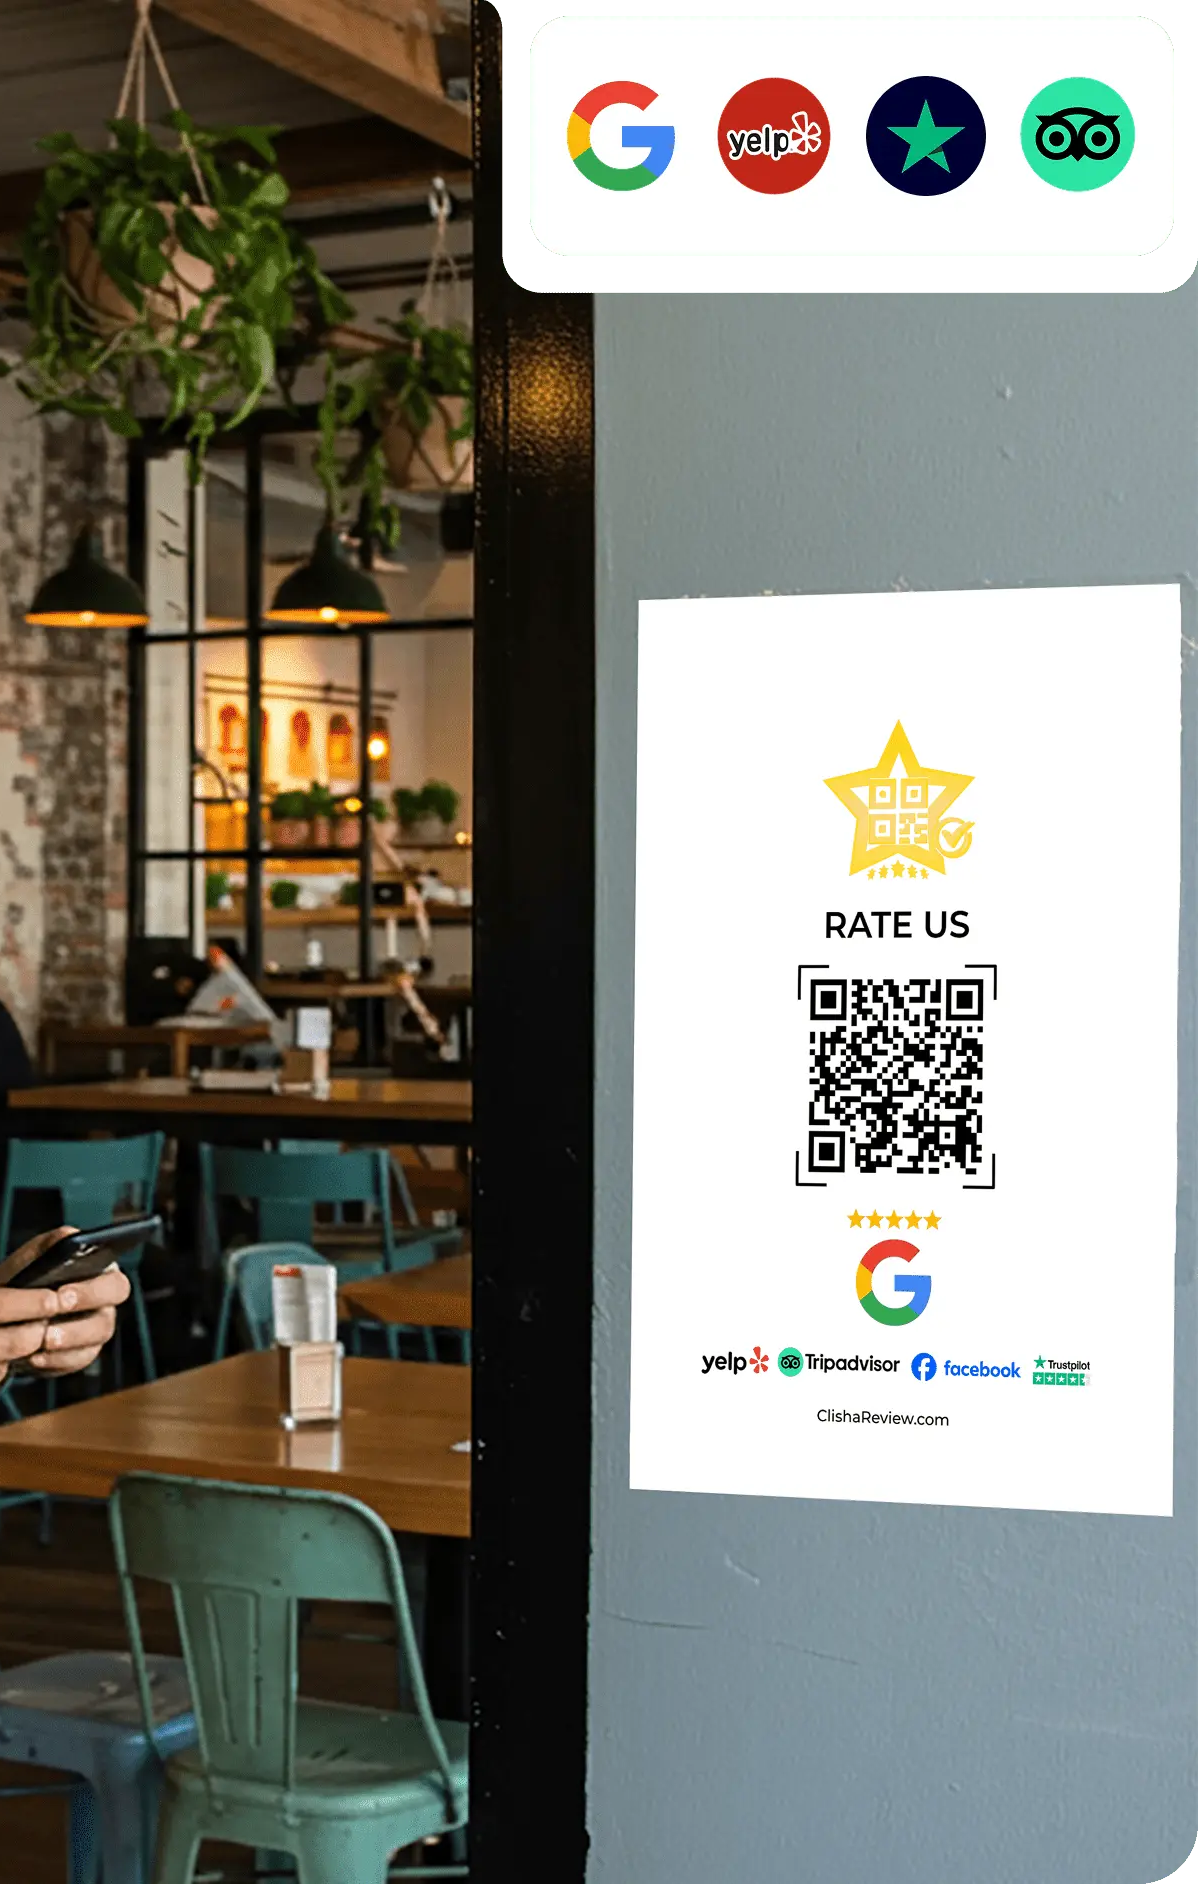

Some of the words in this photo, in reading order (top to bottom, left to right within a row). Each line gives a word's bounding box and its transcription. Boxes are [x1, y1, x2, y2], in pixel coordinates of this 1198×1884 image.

[826, 911, 912, 938] RATE
[925, 910, 969, 938] US
[702, 1352, 746, 1375] yelp
[805, 1354, 900, 1373] Tripadvisor
[944, 1360, 1021, 1378] facebook
[1048, 1360, 1090, 1371] Trustpilot
[817, 1409, 949, 1426] ClishaReview.com
